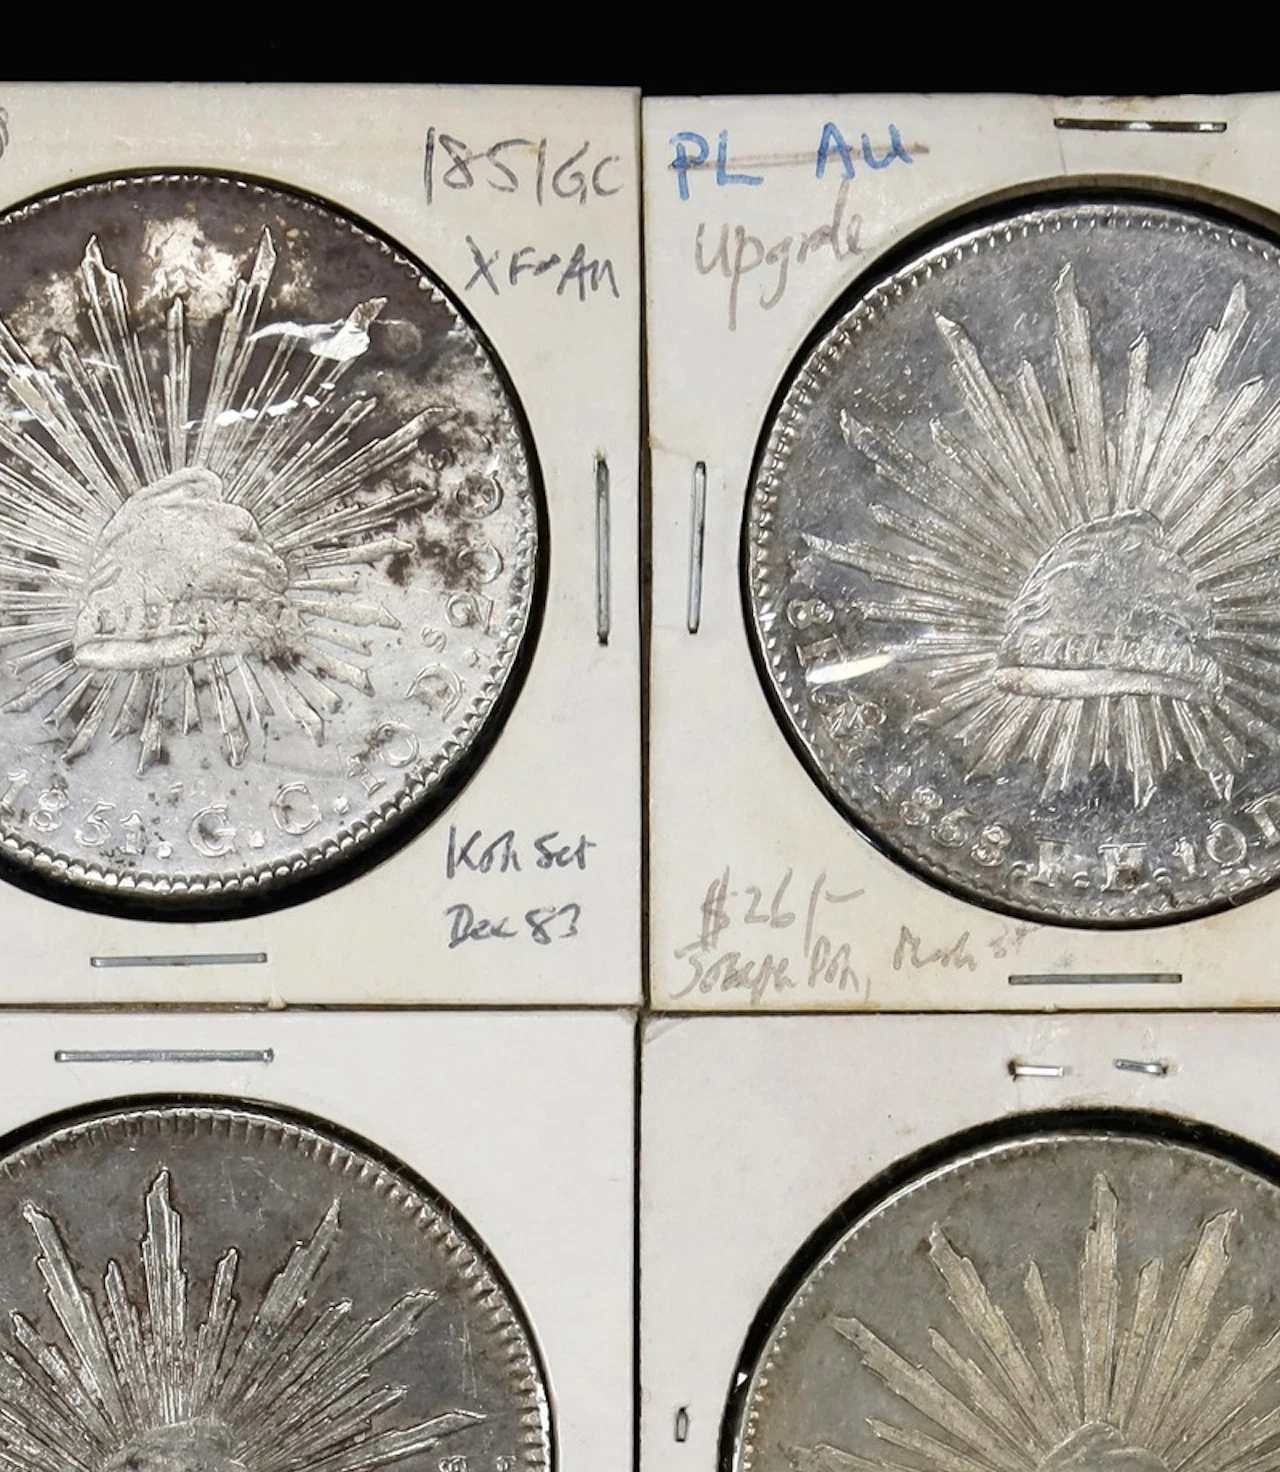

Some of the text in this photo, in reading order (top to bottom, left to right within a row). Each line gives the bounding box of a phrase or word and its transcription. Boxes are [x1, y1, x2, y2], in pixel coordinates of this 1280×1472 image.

[669, 121, 914, 200] PL AU
[445, 903, 581, 948] Dec 83
